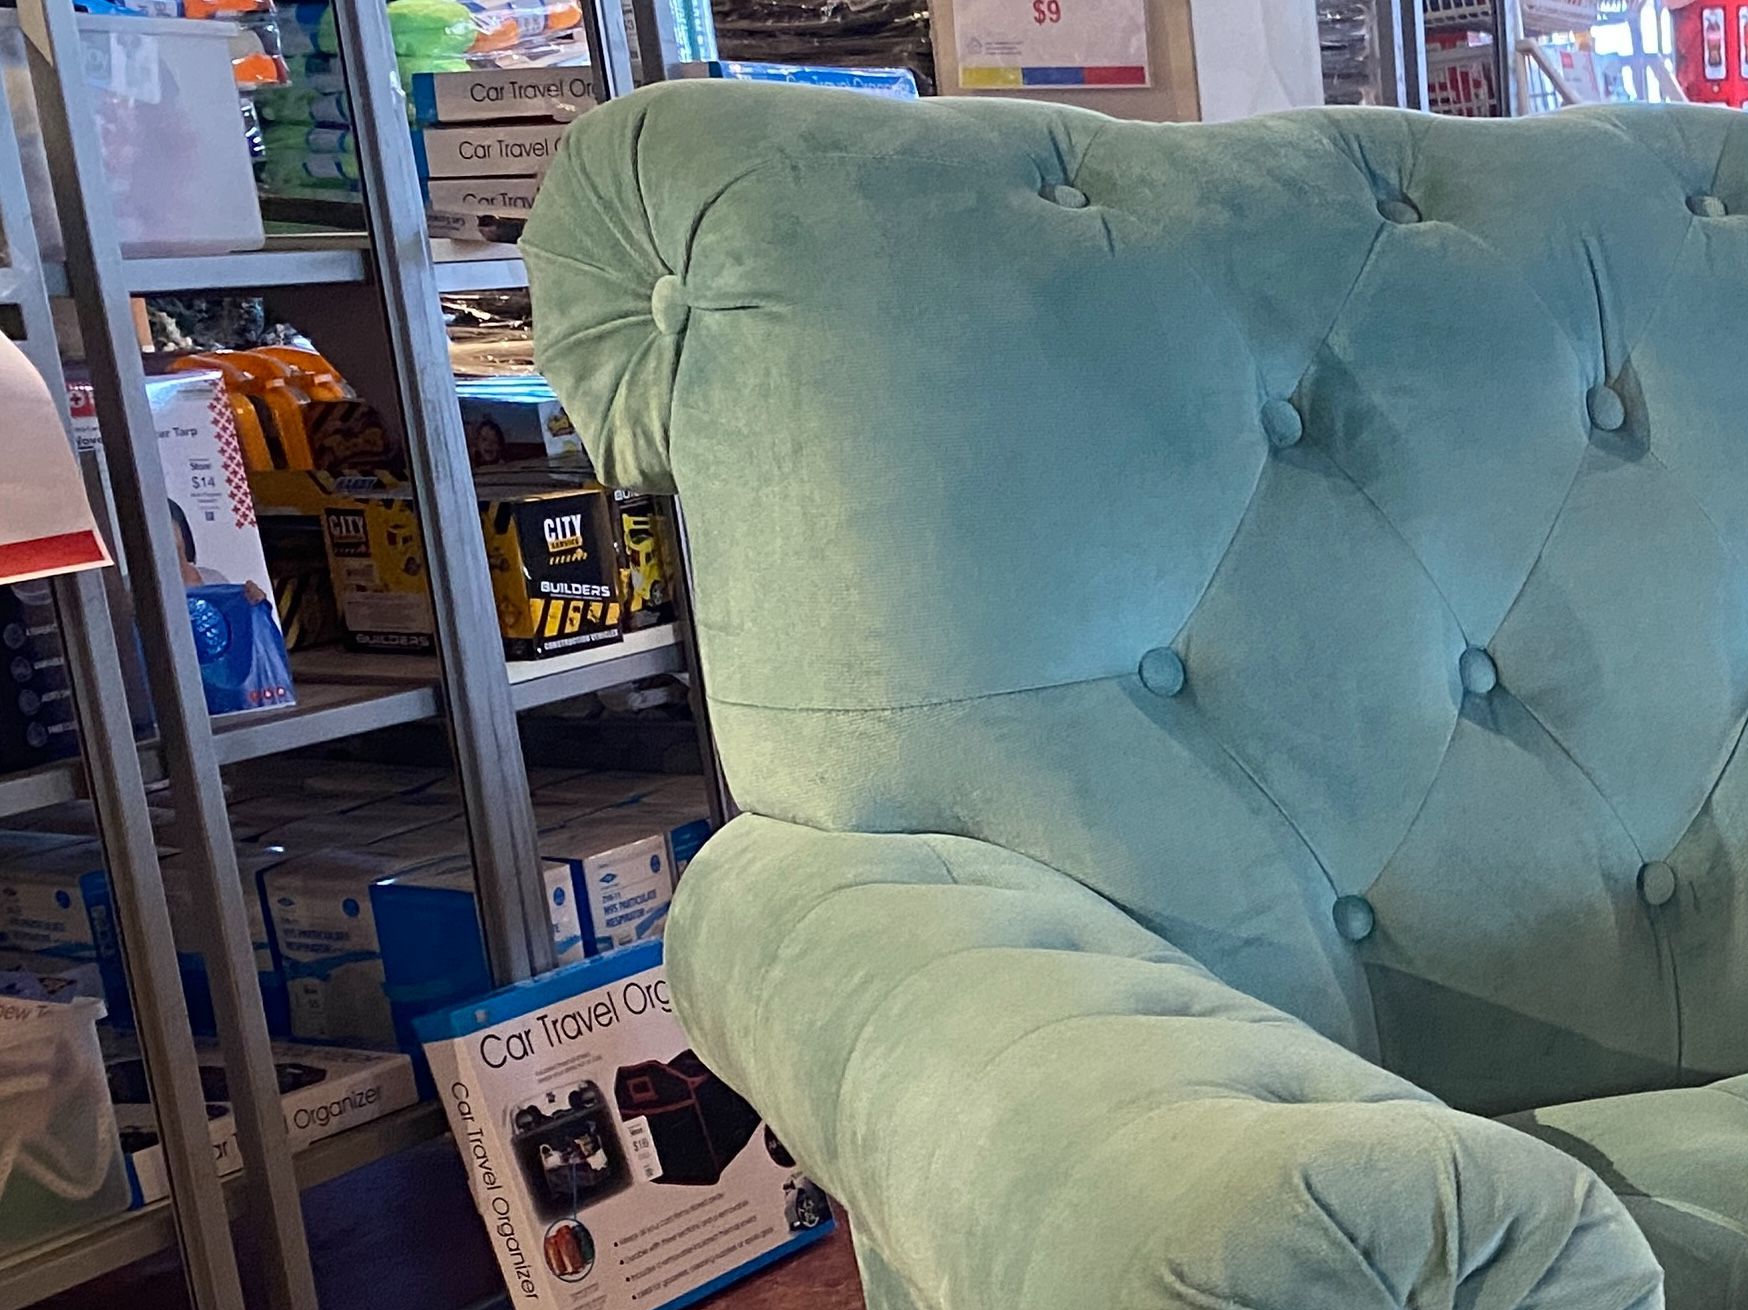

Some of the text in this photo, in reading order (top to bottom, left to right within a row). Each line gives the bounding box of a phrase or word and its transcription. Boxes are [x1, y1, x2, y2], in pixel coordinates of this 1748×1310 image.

[1033, 0, 1061, 25] $9
[470, 83, 504, 102] Car
[509, 79, 564, 100] Travel
[458, 141, 492, 160] Car
[496, 138, 549, 158] Travel
[172, 427, 198, 438] Tarp
[192, 476, 216, 489] $14
[328, 515, 364, 537] CITY
[543, 514, 581, 543] CITY
[540, 581, 611, 597] BUILDERS
[480, 1028, 535, 1068] Car
[536, 991, 620, 1047] Travel
[623, 980, 672, 1014] Org
[293, 1084, 383, 1128] Organizer
[451, 1082, 539, 1300] Car Travel Organizer
